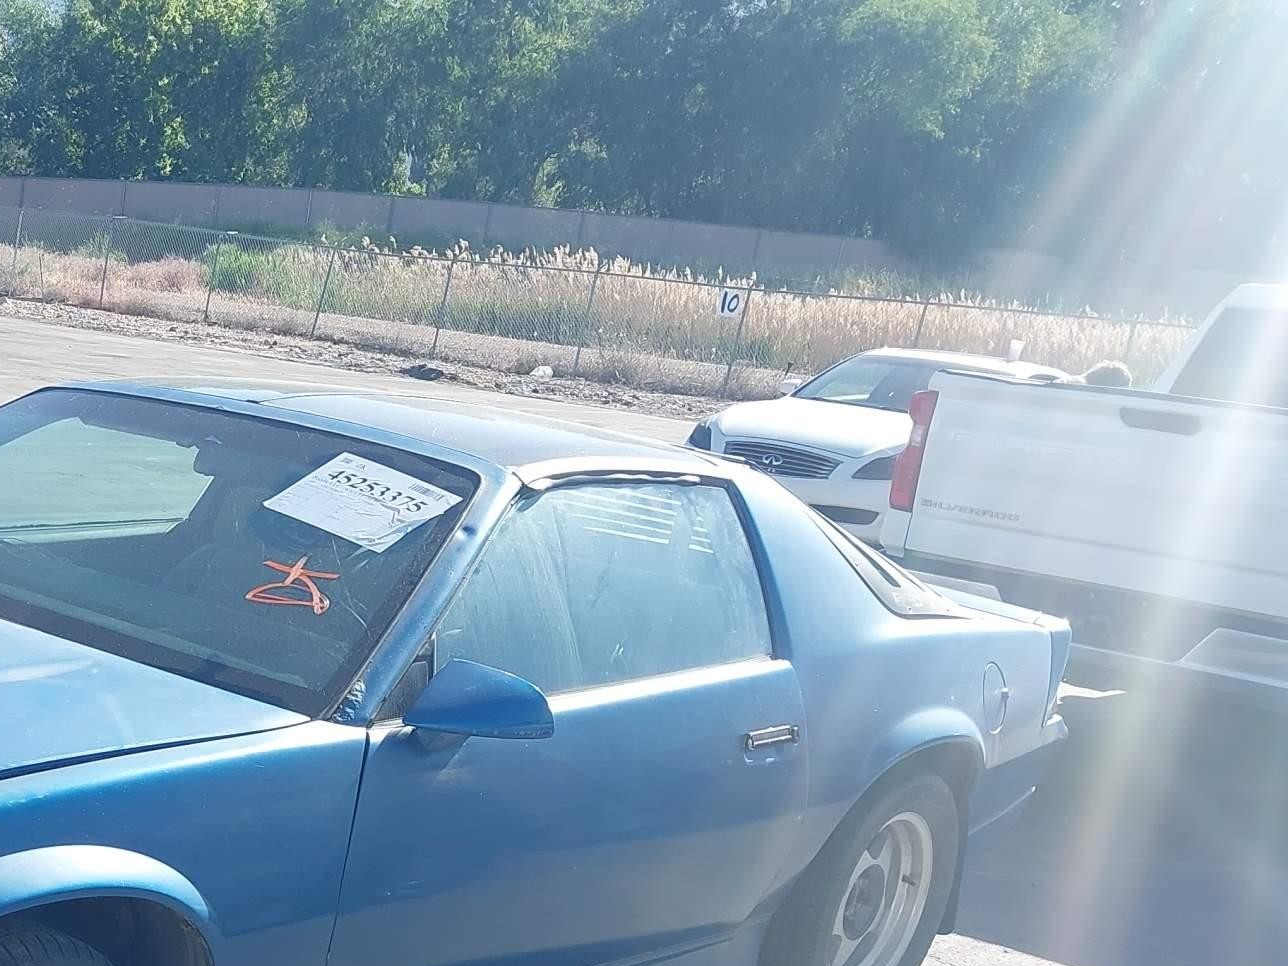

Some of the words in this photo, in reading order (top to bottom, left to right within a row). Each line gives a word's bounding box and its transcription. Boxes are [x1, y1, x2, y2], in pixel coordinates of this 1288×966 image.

[721, 291, 740, 313] 10
[327, 469, 429, 513] 45253375
[921, 498, 1021, 521] SILVERADO
